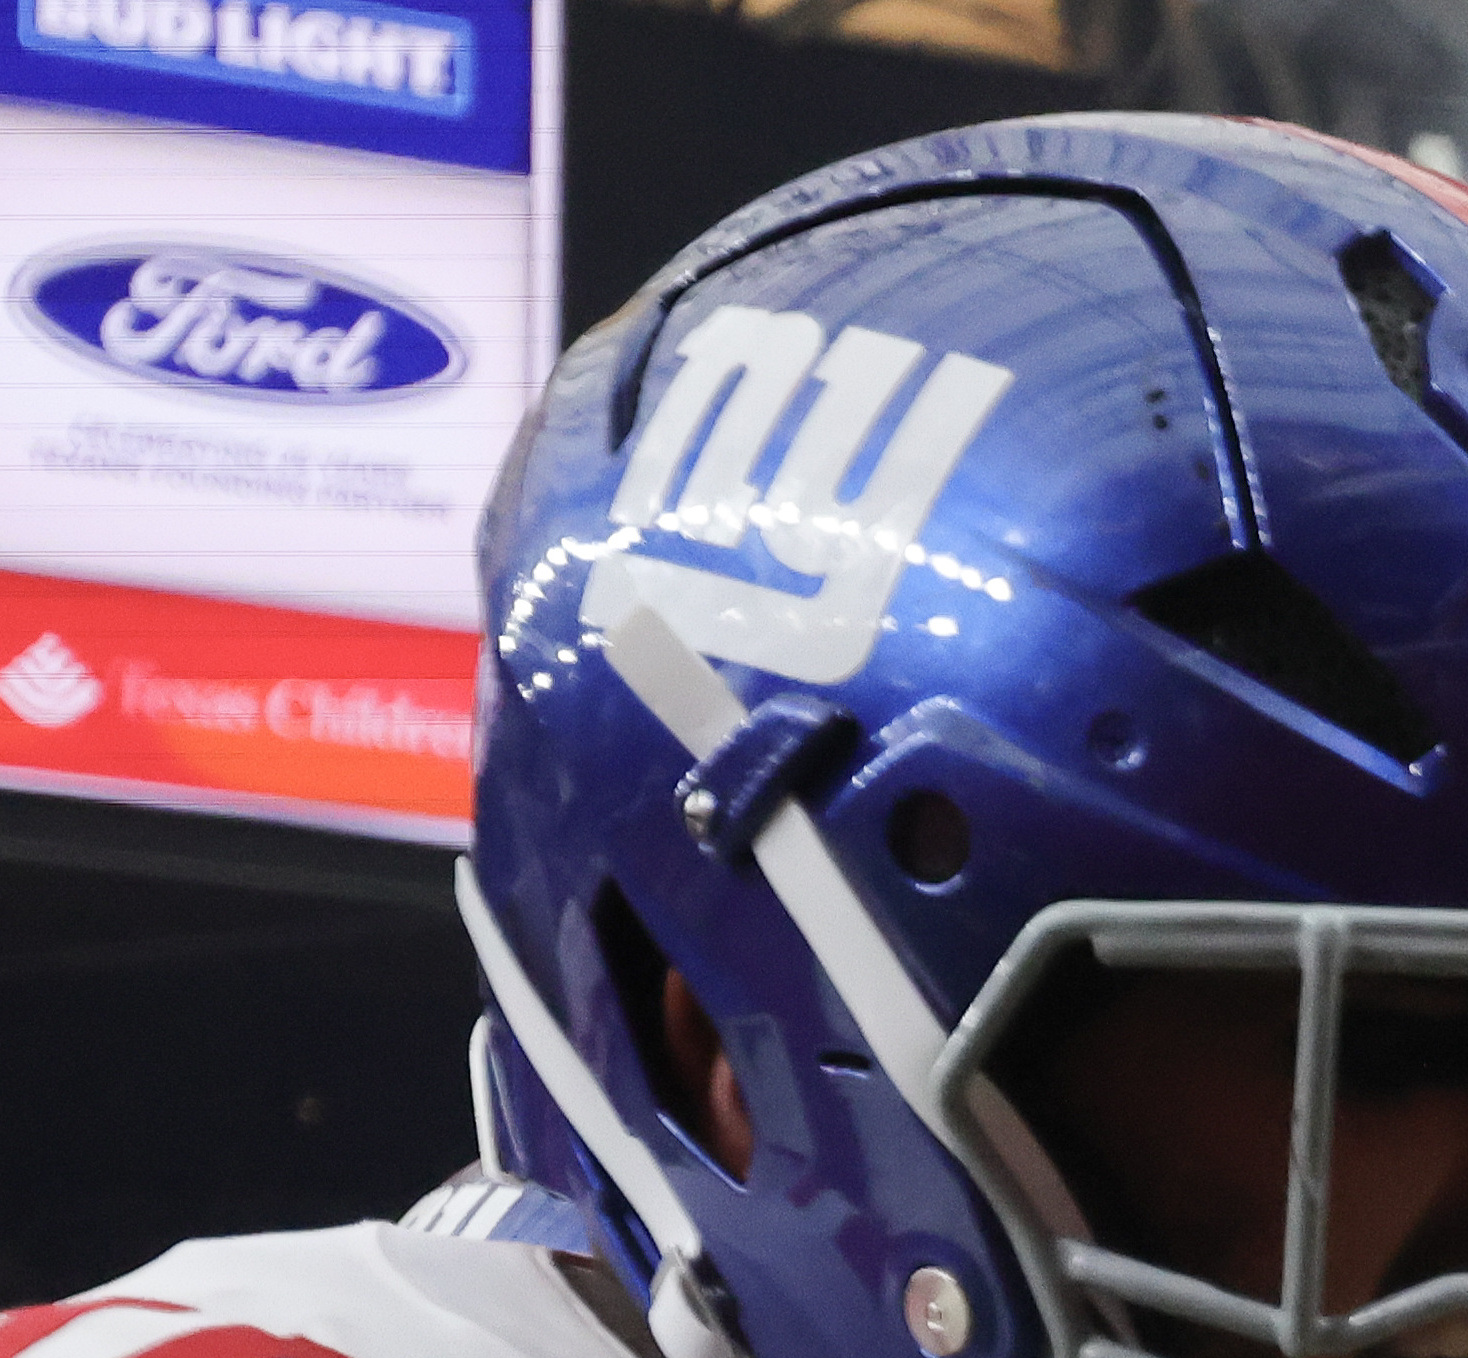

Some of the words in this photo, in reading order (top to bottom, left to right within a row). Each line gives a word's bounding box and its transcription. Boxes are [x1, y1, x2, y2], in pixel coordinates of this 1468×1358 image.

[34, 0, 213, 58] BUD
[214, 0, 453, 98] LIGHT
[101, 254, 388, 389] Ford
